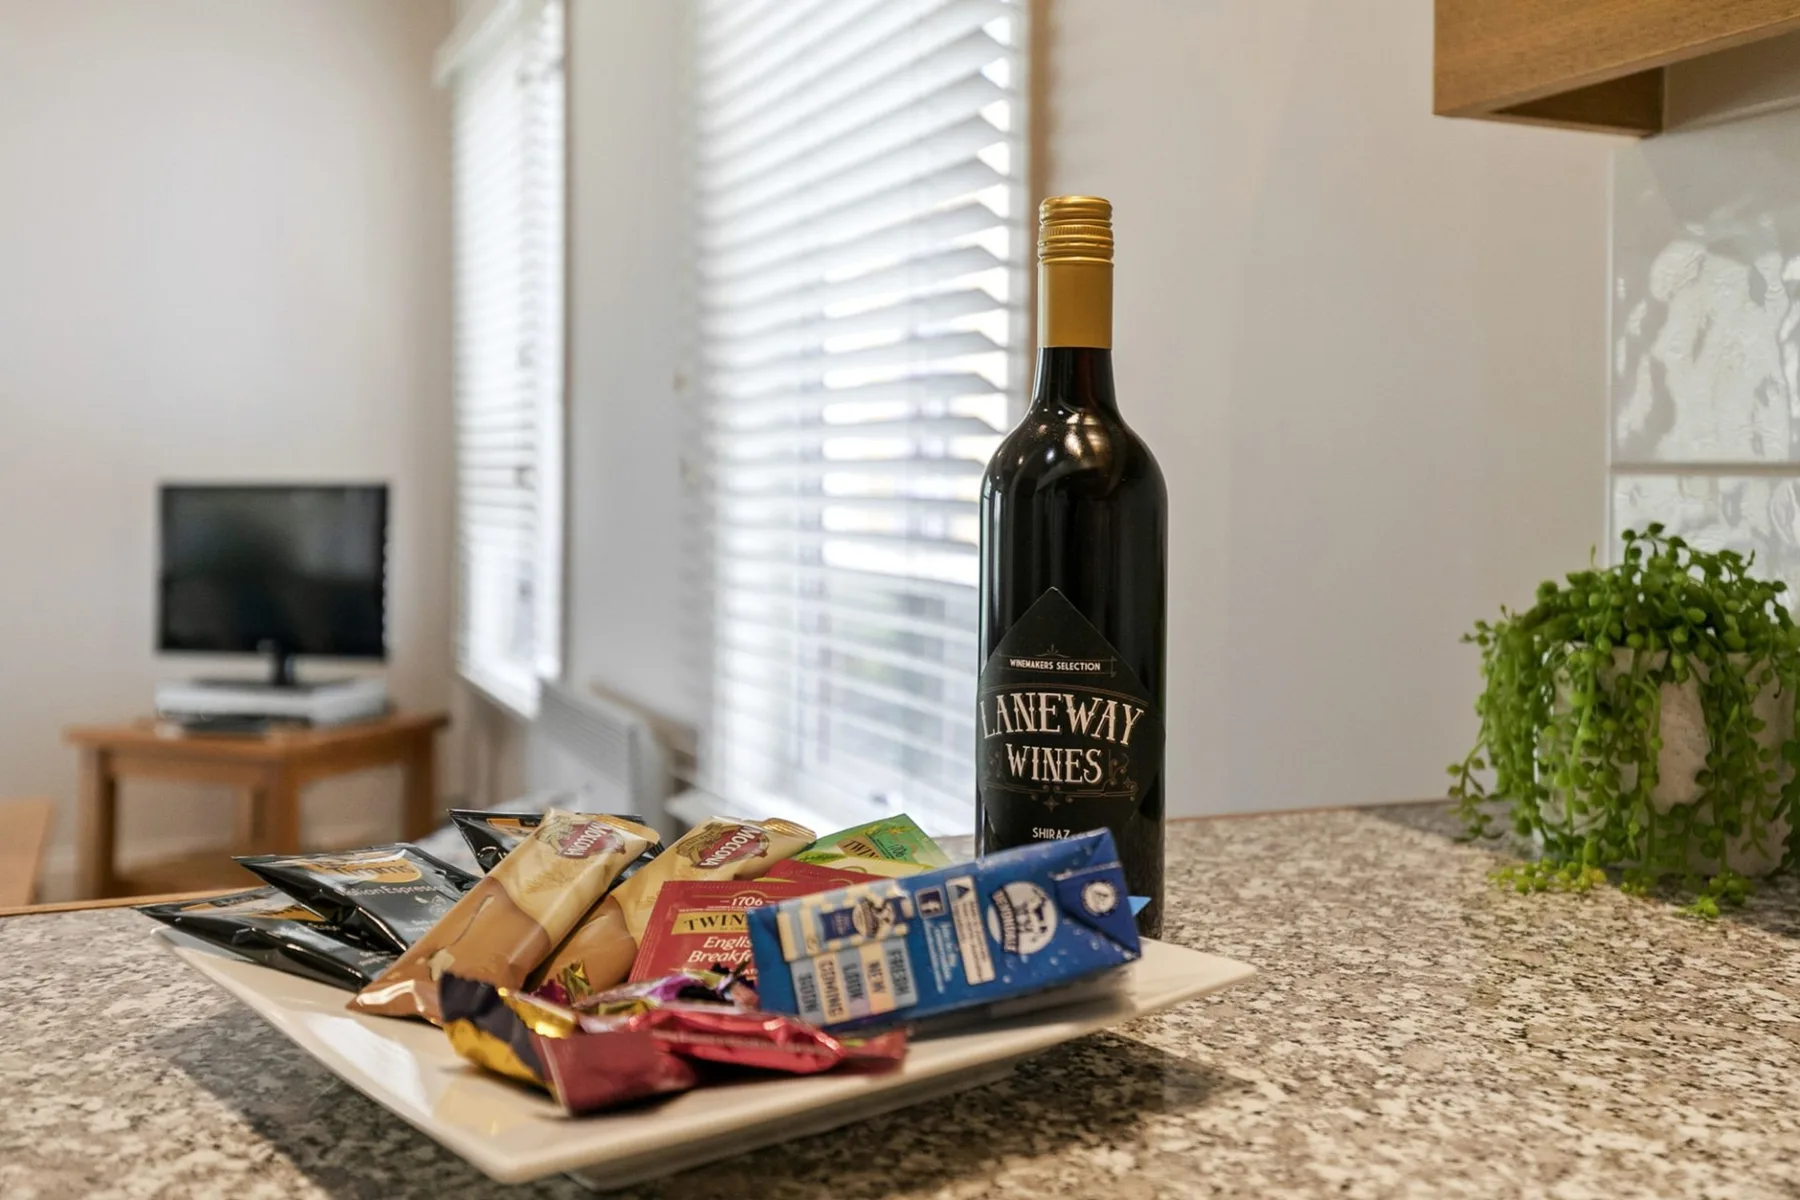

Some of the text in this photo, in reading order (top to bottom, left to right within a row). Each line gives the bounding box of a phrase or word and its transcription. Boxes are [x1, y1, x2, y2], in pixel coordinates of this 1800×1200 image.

[1009, 658, 1101, 671] WINEMAKERS SELECTION
[980, 692, 1144, 745] LANEWAY
[1005, 743, 1102, 784] WINES
[1032, 827, 1070, 839] SHIRAZ
[843, 840, 880, 858] TWIN
[731, 896, 763, 906] 1706
[684, 914, 745, 931] TWIN
[702, 936, 753, 951] Englis
